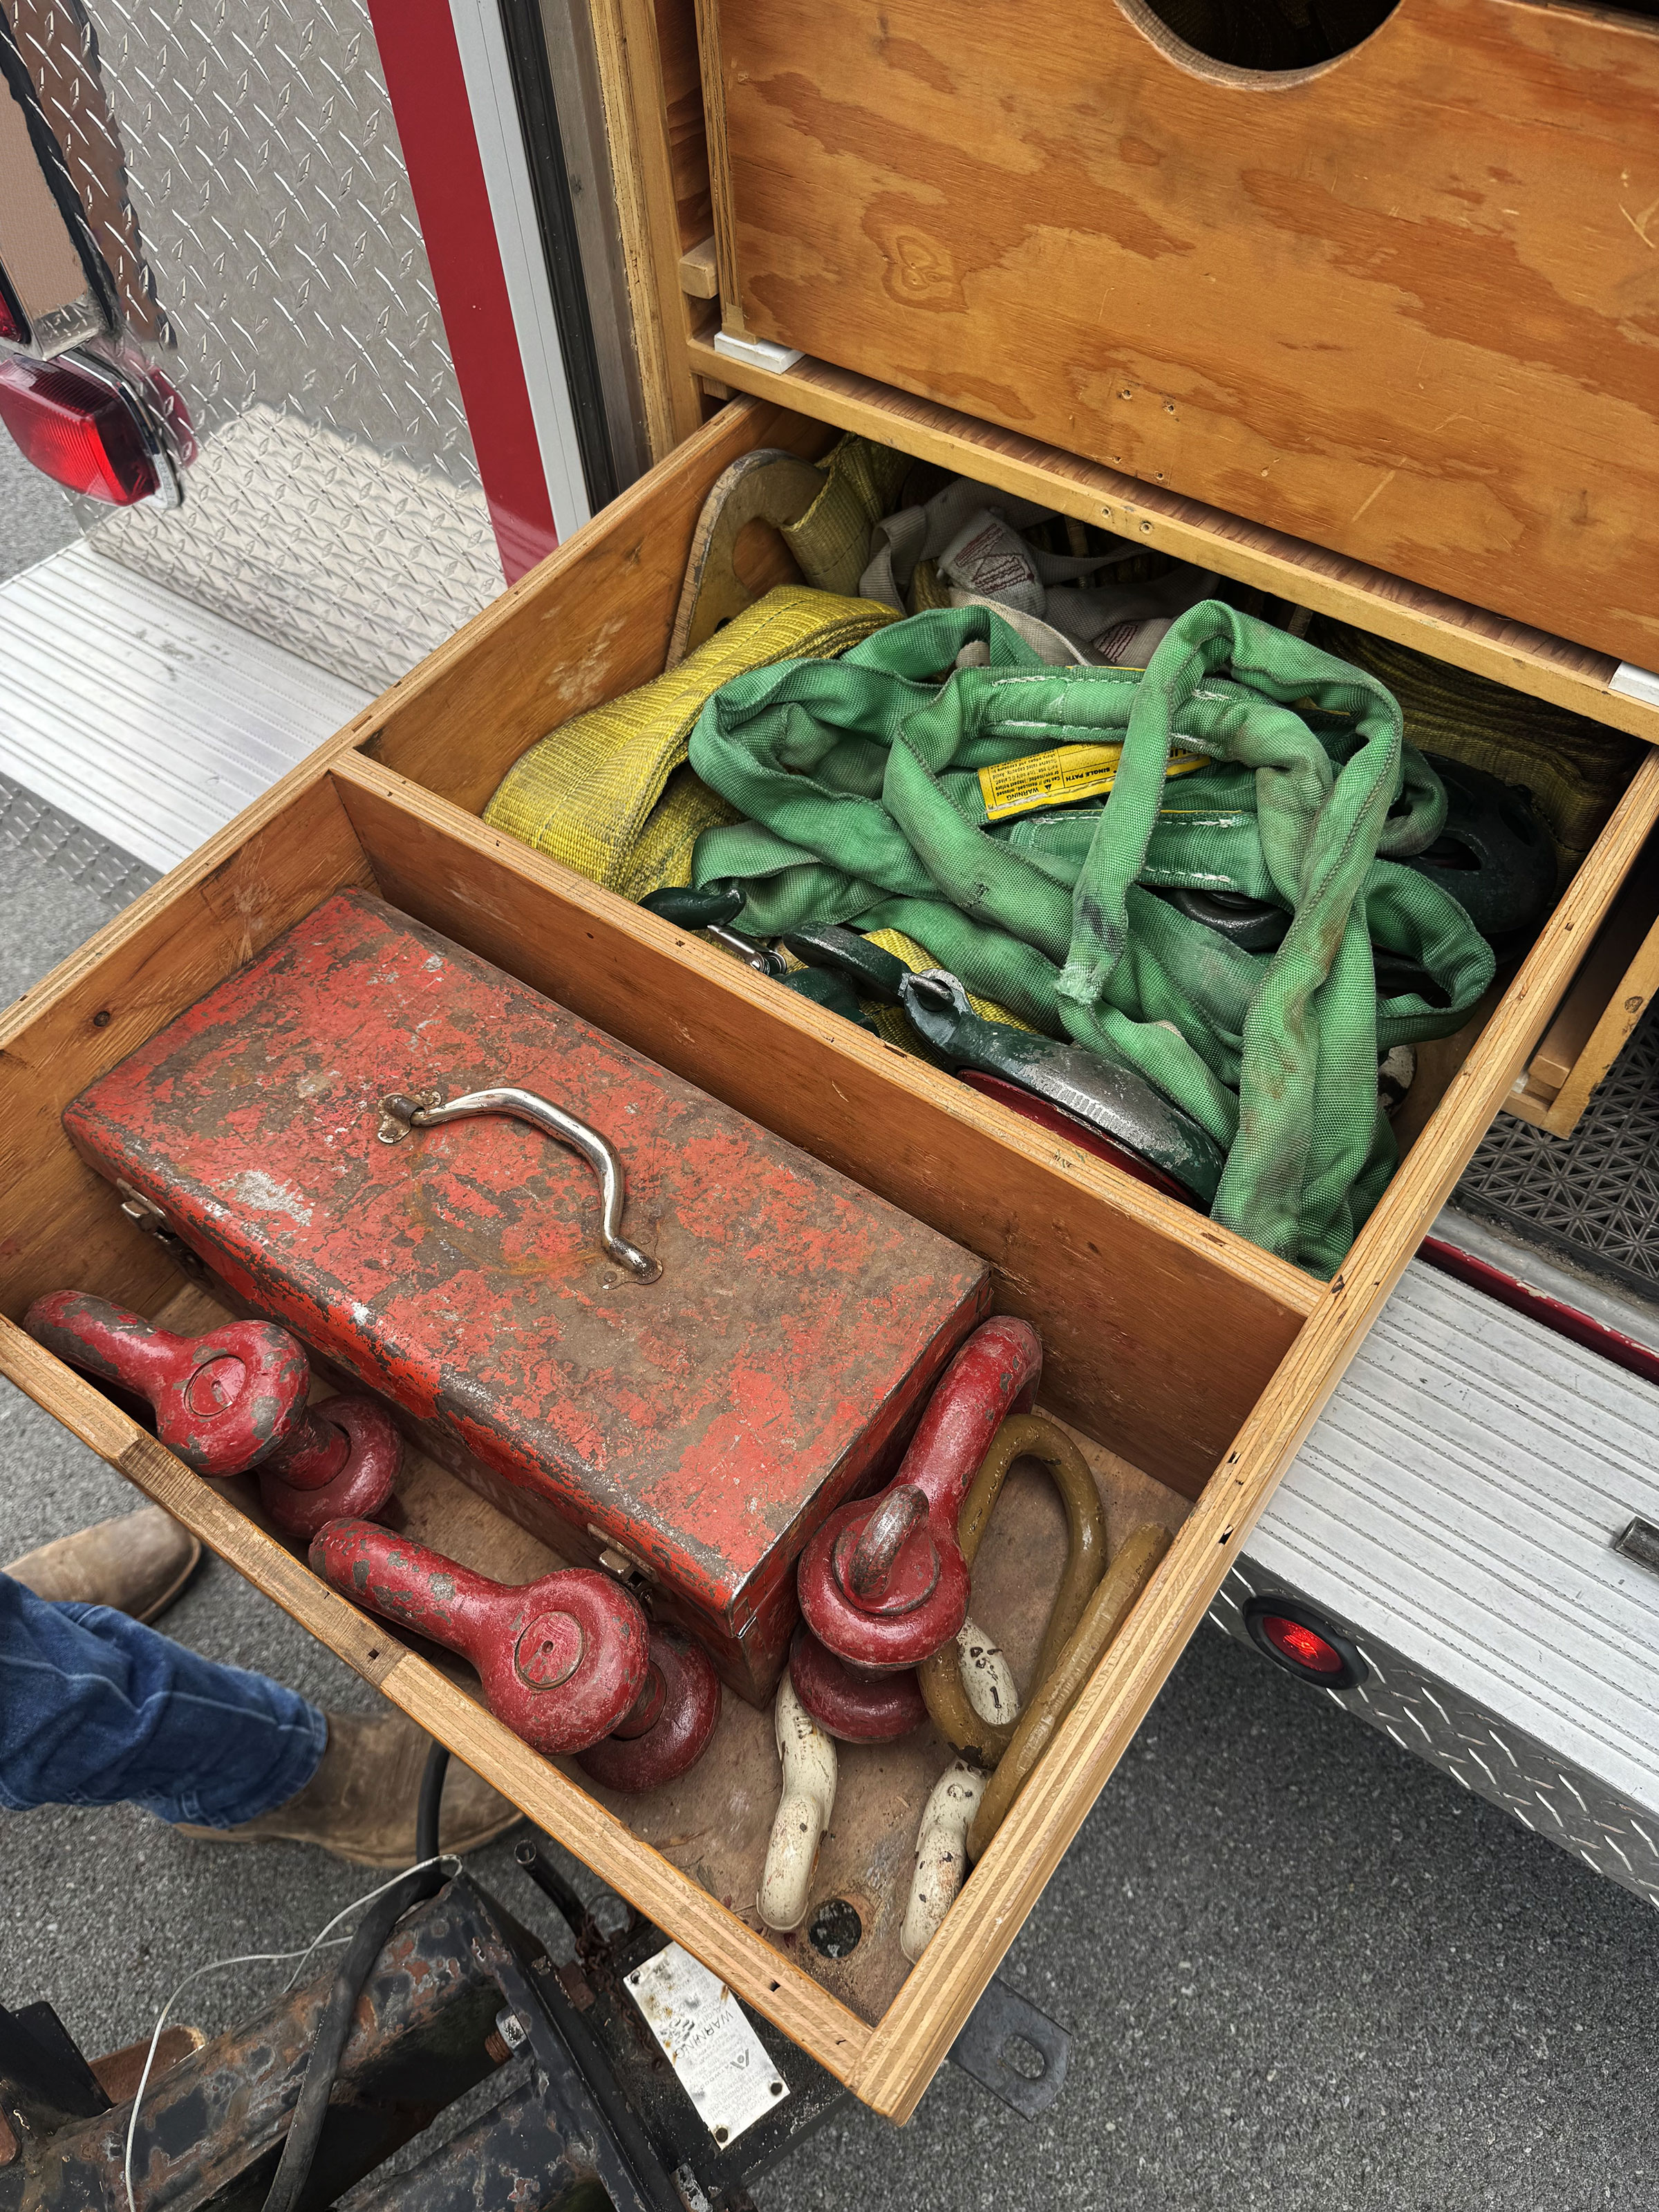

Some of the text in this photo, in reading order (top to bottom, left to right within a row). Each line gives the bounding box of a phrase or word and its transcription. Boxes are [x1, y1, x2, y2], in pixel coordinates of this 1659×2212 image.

[1065, 766, 1110, 782] SINGLE PATH
[995, 783, 1010, 791] before
[996, 787, 1015, 796] misused
[1006, 787, 1039, 800] WARNING
[672, 2009, 733, 2061] WARNING
